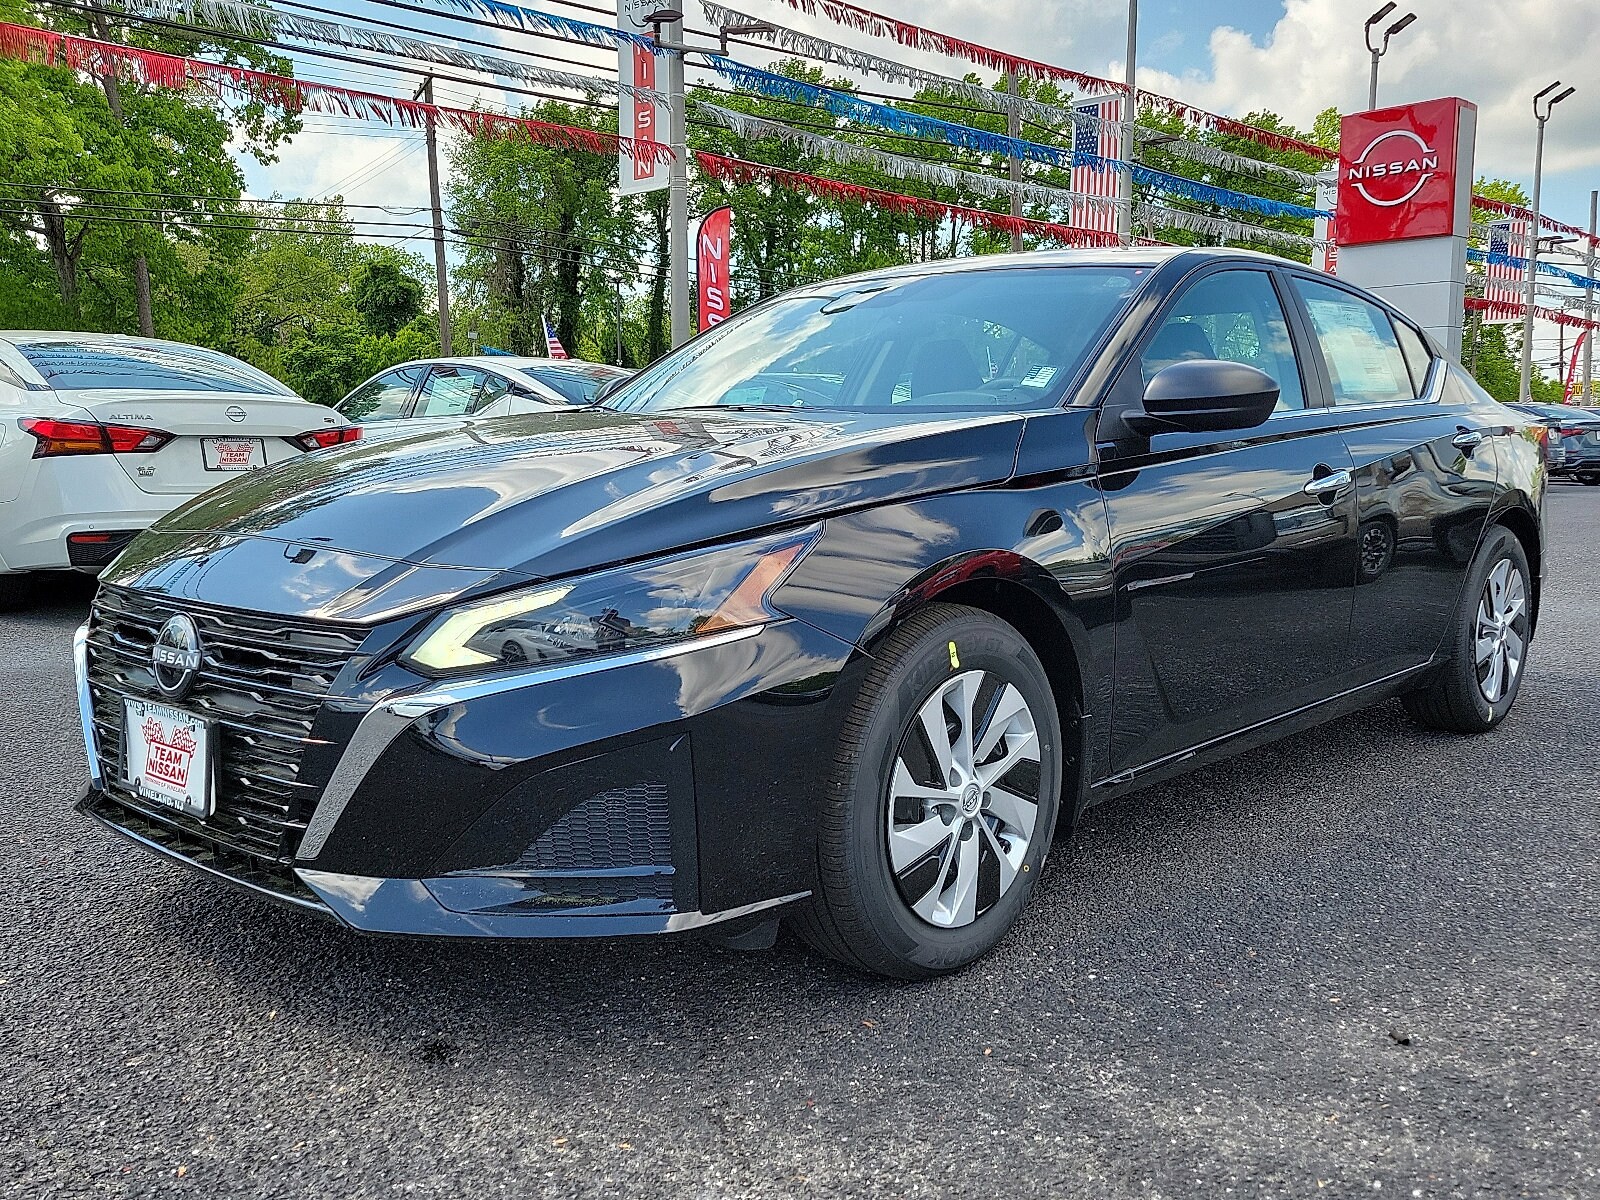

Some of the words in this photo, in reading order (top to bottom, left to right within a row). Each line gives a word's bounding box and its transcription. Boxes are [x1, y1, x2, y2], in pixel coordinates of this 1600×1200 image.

[624, 0, 656, 12] NISSA
[1349, 156, 1437, 180] NISSAN
[153, 647, 198, 668] NISSAN
[154, 746, 183, 767] TEAM
[148, 758, 186, 782] NISSAN
[174, 794, 184, 811] NJ
